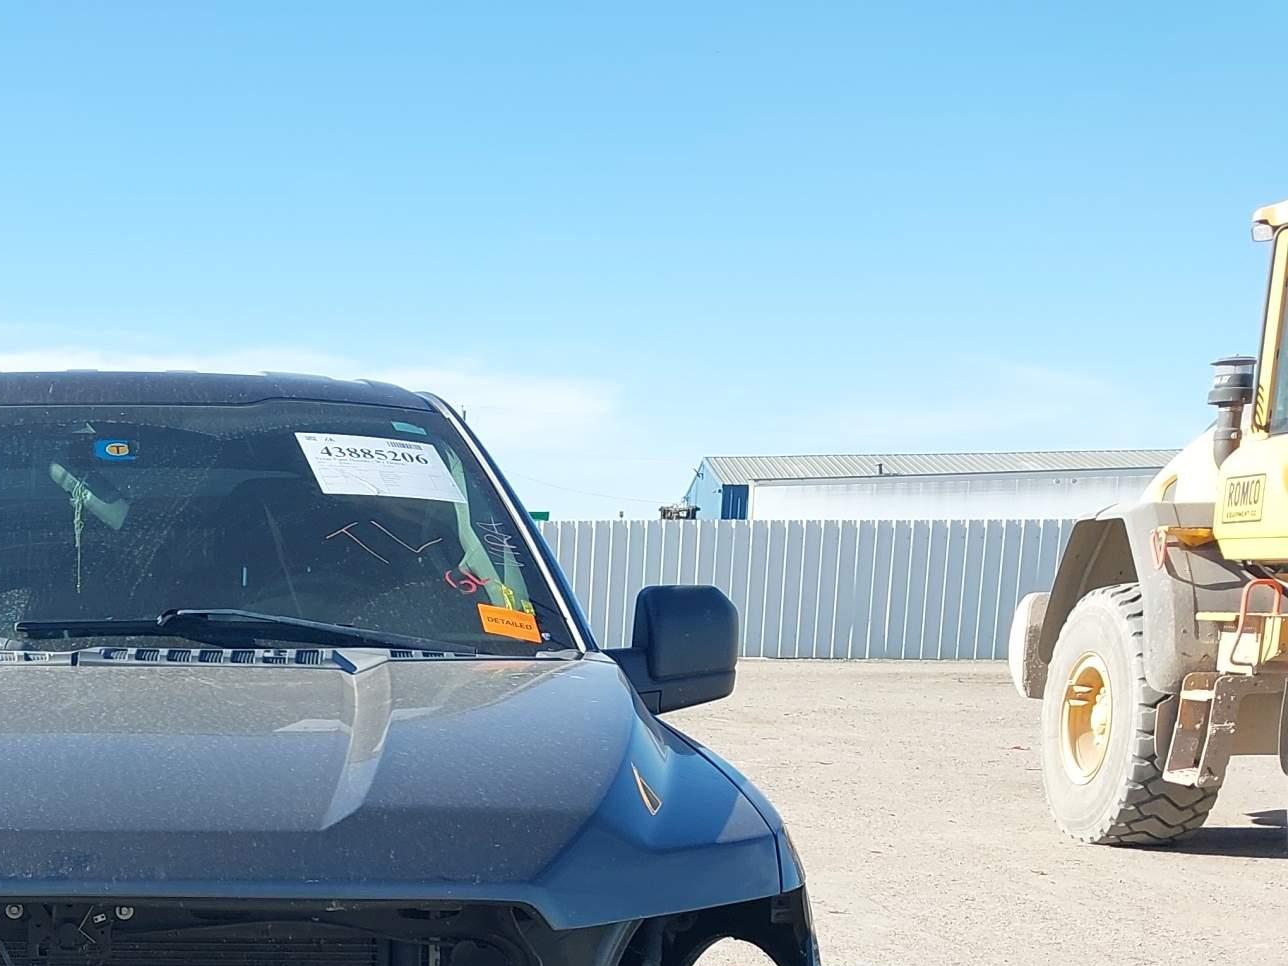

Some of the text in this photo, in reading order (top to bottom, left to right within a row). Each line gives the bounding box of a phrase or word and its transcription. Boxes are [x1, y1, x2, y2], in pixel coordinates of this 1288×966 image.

[320, 445, 429, 465] 43885206
[1227, 480, 1261, 507] ROMCO
[487, 616, 532, 631] DETAILED
